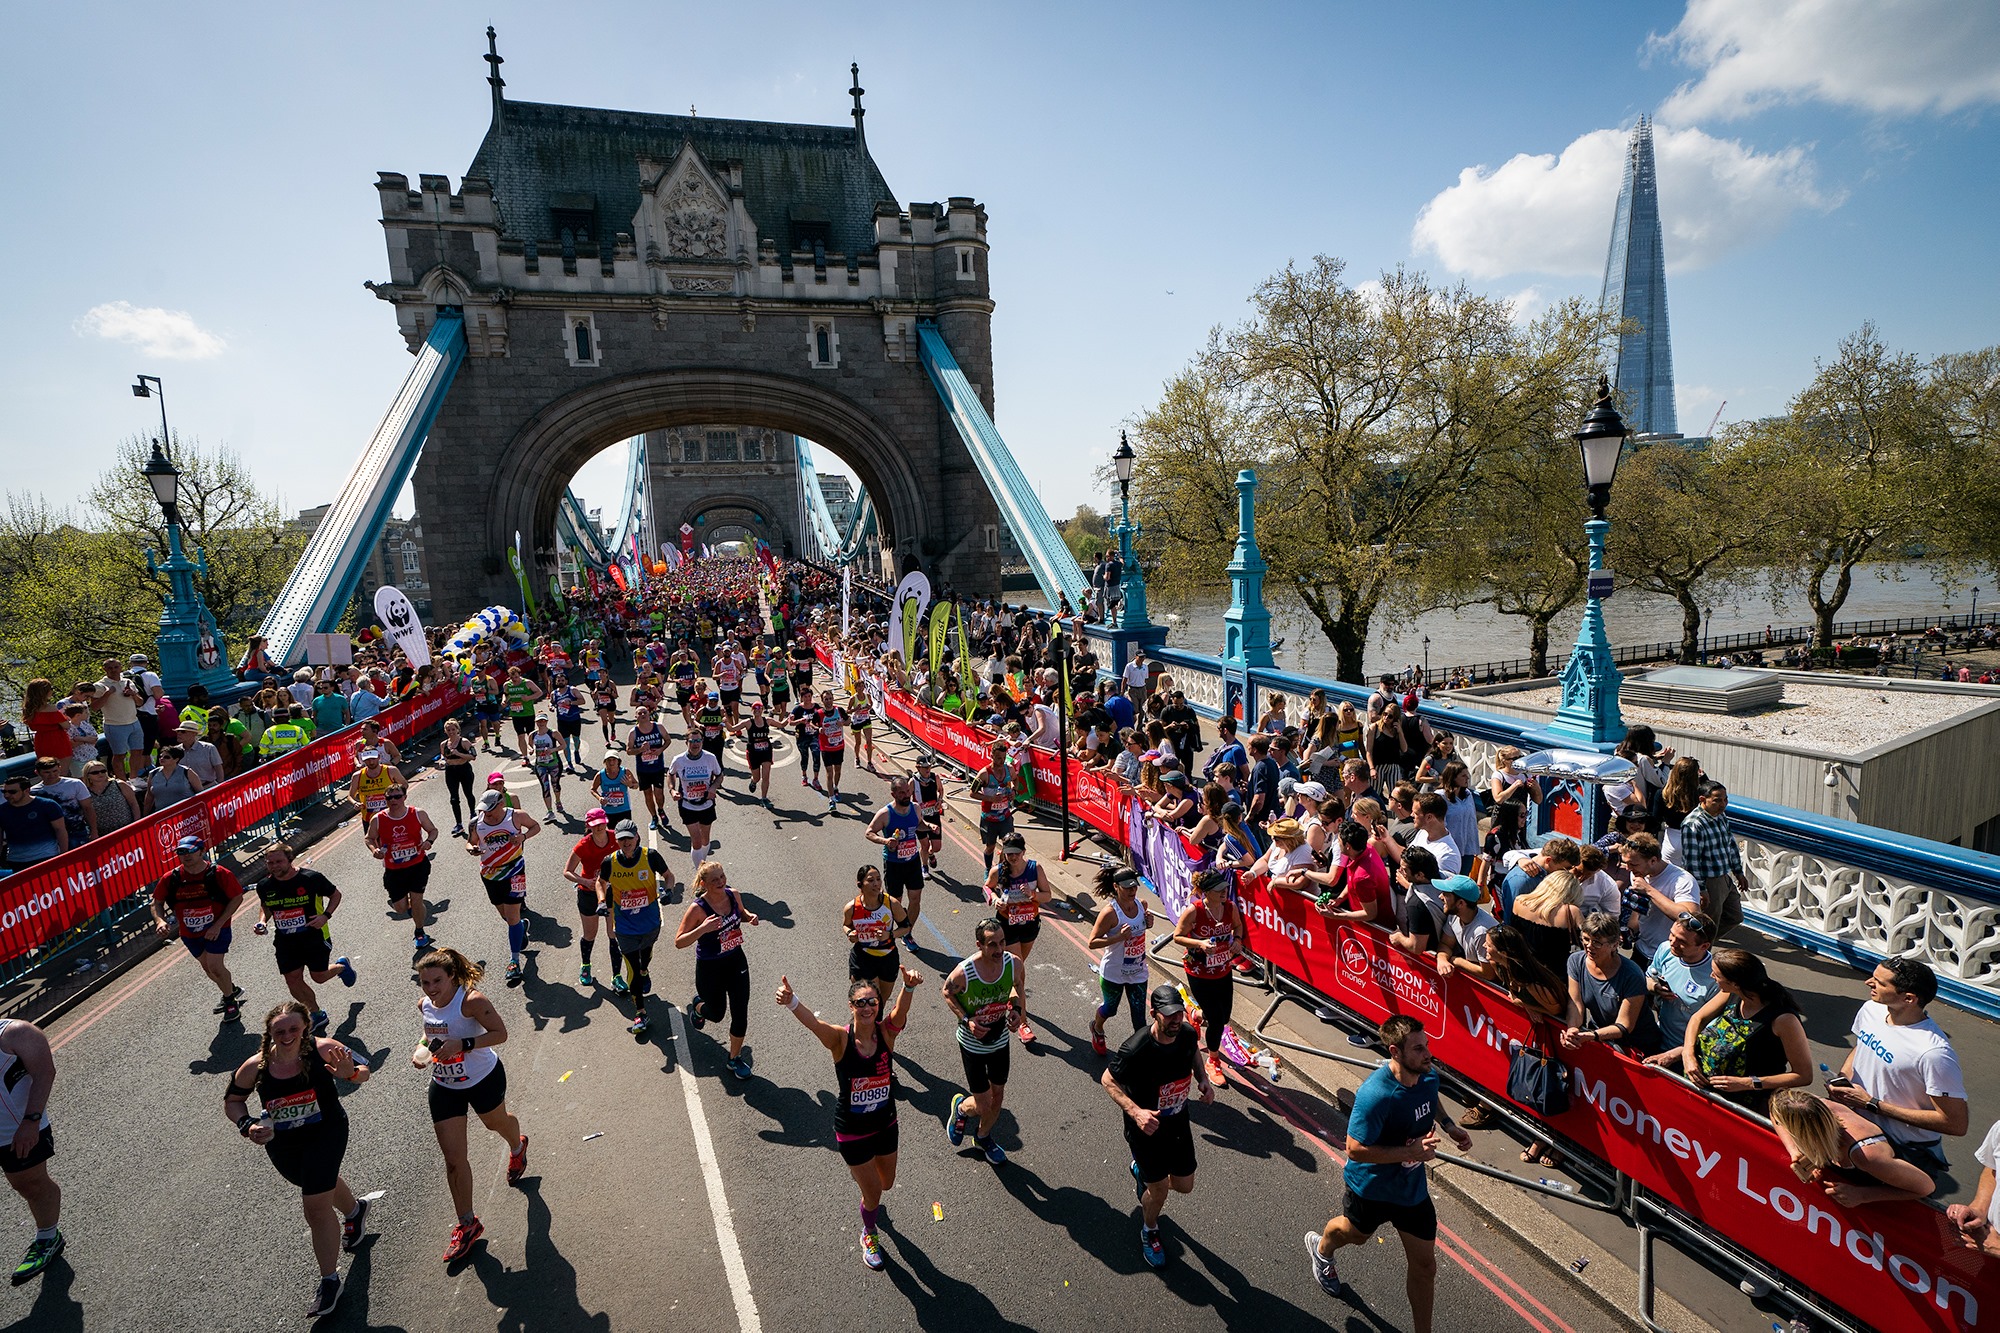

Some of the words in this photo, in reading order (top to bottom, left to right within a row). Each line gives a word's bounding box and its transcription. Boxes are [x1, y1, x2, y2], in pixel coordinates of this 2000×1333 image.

[393, 626, 413, 639] WWF
[636, 733, 660, 742] JONNY
[946, 726, 963, 746] Virgin
[963, 734, 985, 759] Money
[213, 794, 243, 820] Virgin
[243, 780, 276, 805] Money
[276, 766, 306, 789] London
[306, 751, 341, 777] Marathon
[1032, 767, 1061, 787] ratho
[174, 814, 199, 831] LONDON
[67, 846, 144, 897] Marathon
[621, 898, 647, 908] 42827
[185, 915, 213, 925] 19212
[276, 916, 304, 927] 16658
[1238, 895, 1312, 949] arathon
[1345, 944, 1365, 968] Virgin
[1341, 969, 1366, 989] money
[1372, 955, 1422, 989] LONDON
[1371, 969, 1439, 1013] MARATHON
[1858, 1029, 1894, 1064] adidas
[288, 1093, 314, 1103] money
[852, 1086, 889, 1102] 60989
[271, 1102, 317, 1120] 23977
[1414, 1101, 1431, 1121] ALEX
[1574, 1066, 1721, 1178] Money
[1738, 1157, 1978, 1327] London
